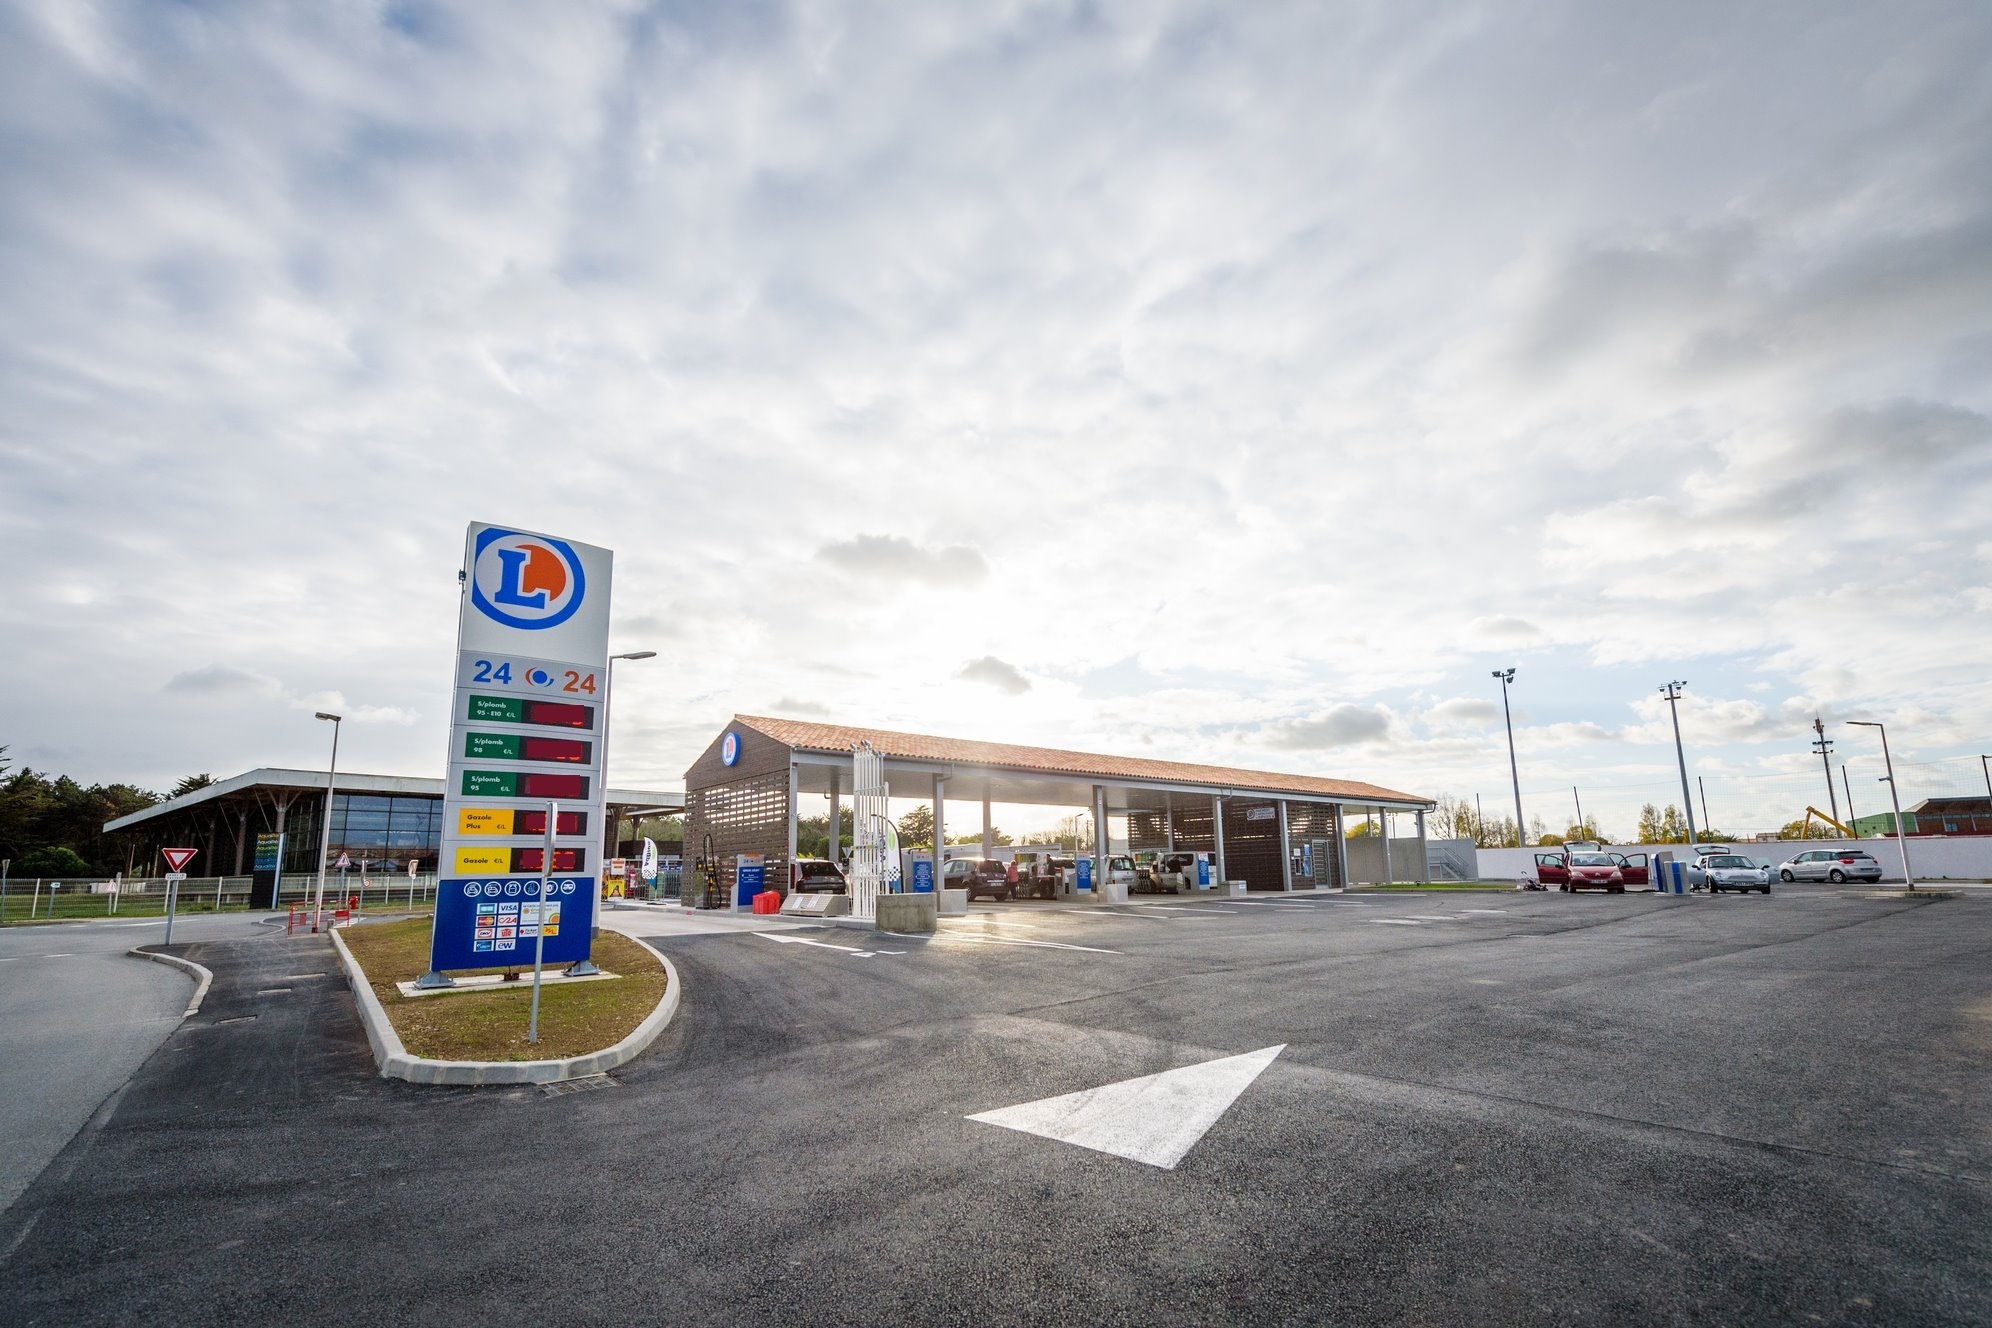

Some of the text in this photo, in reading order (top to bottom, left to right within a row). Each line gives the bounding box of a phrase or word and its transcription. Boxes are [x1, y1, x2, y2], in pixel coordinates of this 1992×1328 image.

[494, 548, 546, 609] L
[473, 659, 596, 694] 24 24
[477, 701, 506, 709] S/plomb
[476, 709, 486, 717] 95
[474, 738, 504, 746] S/plomb
[471, 775, 501, 783] S/plomb
